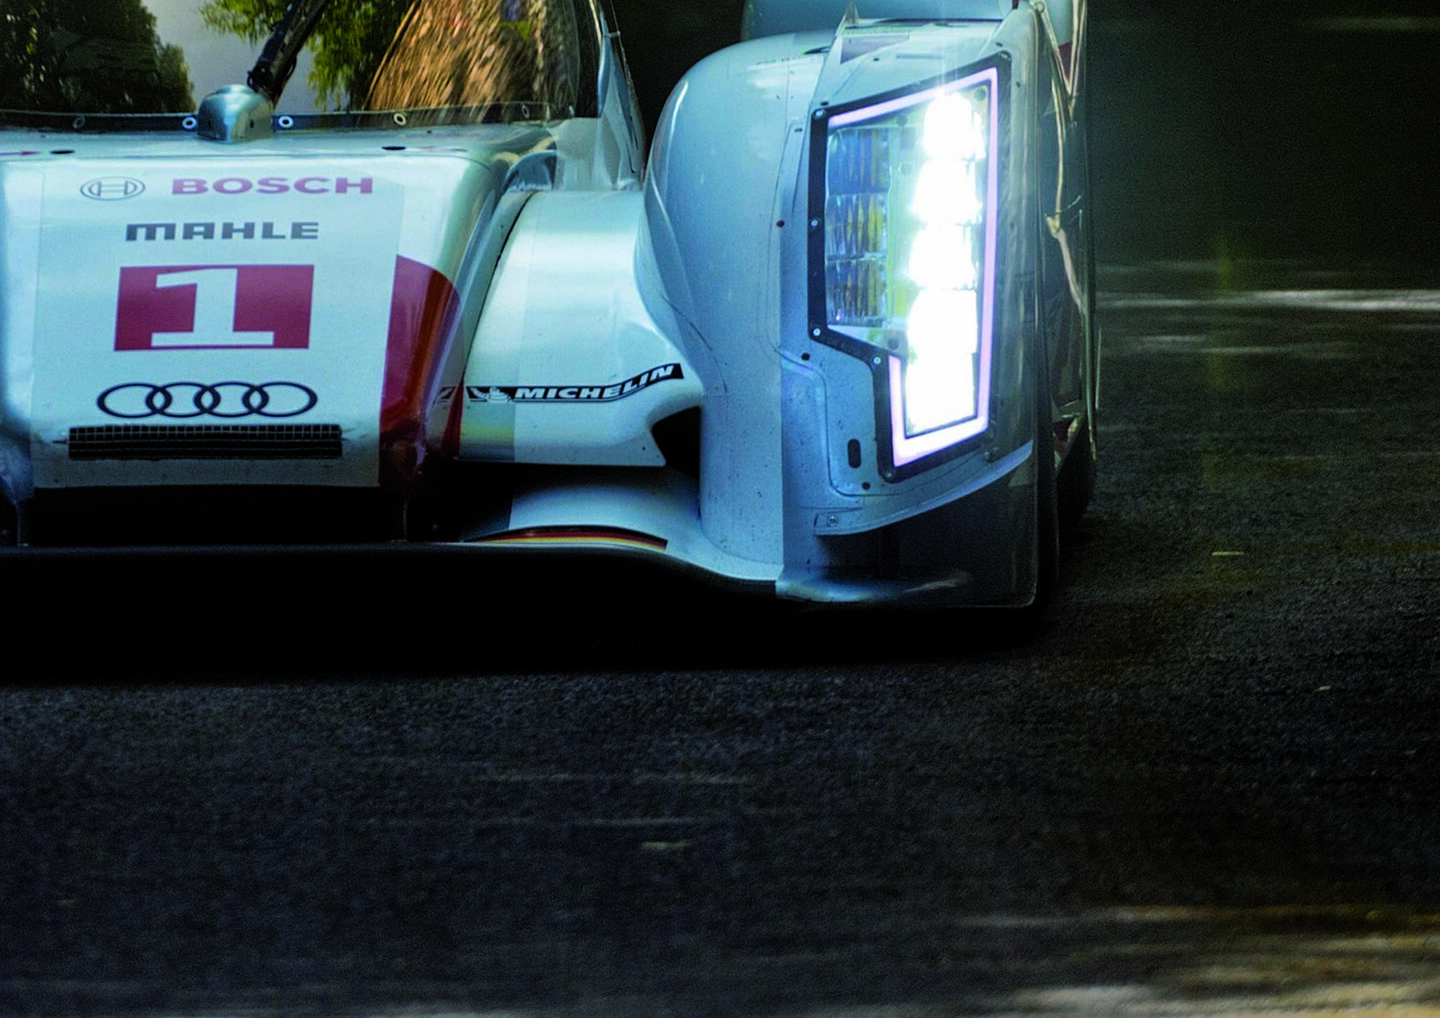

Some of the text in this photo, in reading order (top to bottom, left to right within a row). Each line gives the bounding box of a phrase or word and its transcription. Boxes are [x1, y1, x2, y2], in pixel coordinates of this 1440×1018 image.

[170, 176, 374, 196] BOSCH
[124, 221, 320, 242] MAHLE
[150, 267, 275, 348] 1
[513, 365, 676, 400] MICHELIN
